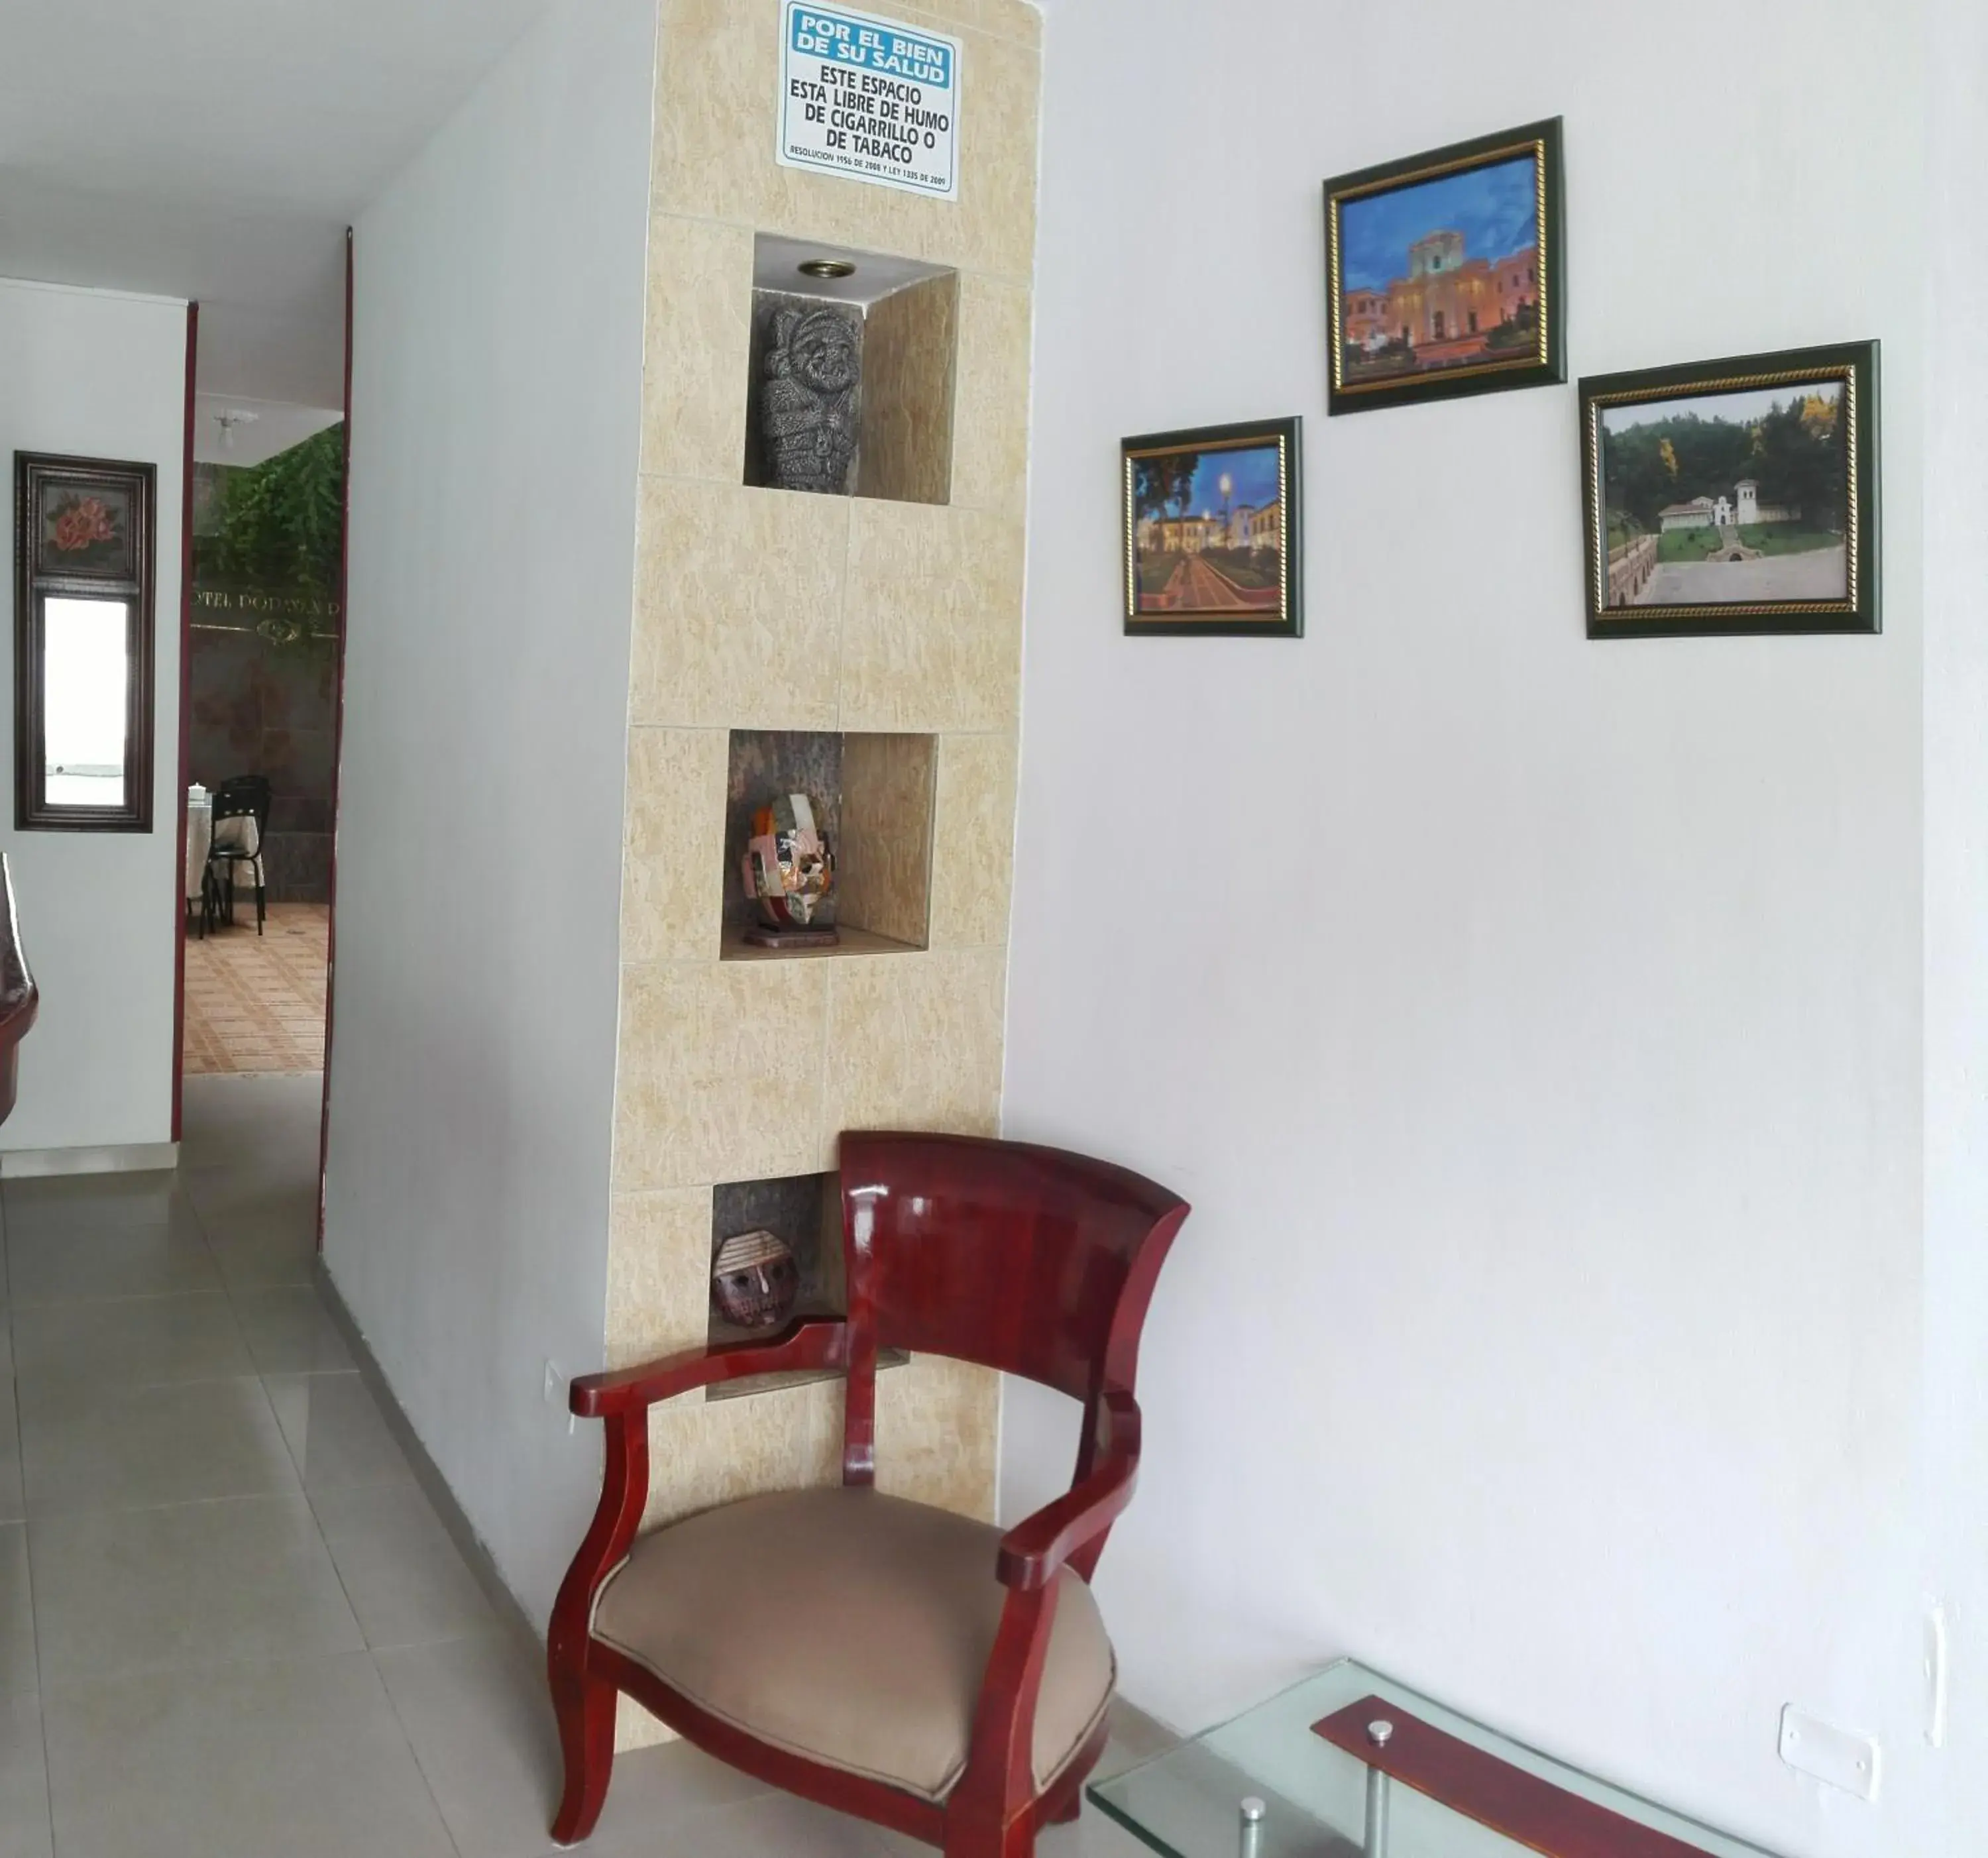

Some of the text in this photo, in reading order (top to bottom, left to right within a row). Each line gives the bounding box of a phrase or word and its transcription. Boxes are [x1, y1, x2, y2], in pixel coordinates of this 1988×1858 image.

[798, 32, 944, 82] DE SU SALUD
[801, 15, 943, 66] POR EL BIEN
[791, 78, 949, 132] ESTA LIBRE DE HUMO
[820, 65, 921, 105] ESTE ESPACIO
[805, 103, 935, 149] DE CIGARRILLO O
[826, 129, 912, 164] DE TABACO
[790, 145, 834, 161] RESOLUCION
[837, 154, 852, 165] 1956
[889, 166, 900, 175] LEY
[903, 170, 918, 179] 1335
[930, 176, 946, 185] 2009
[190, 590, 232, 610] OTEL
